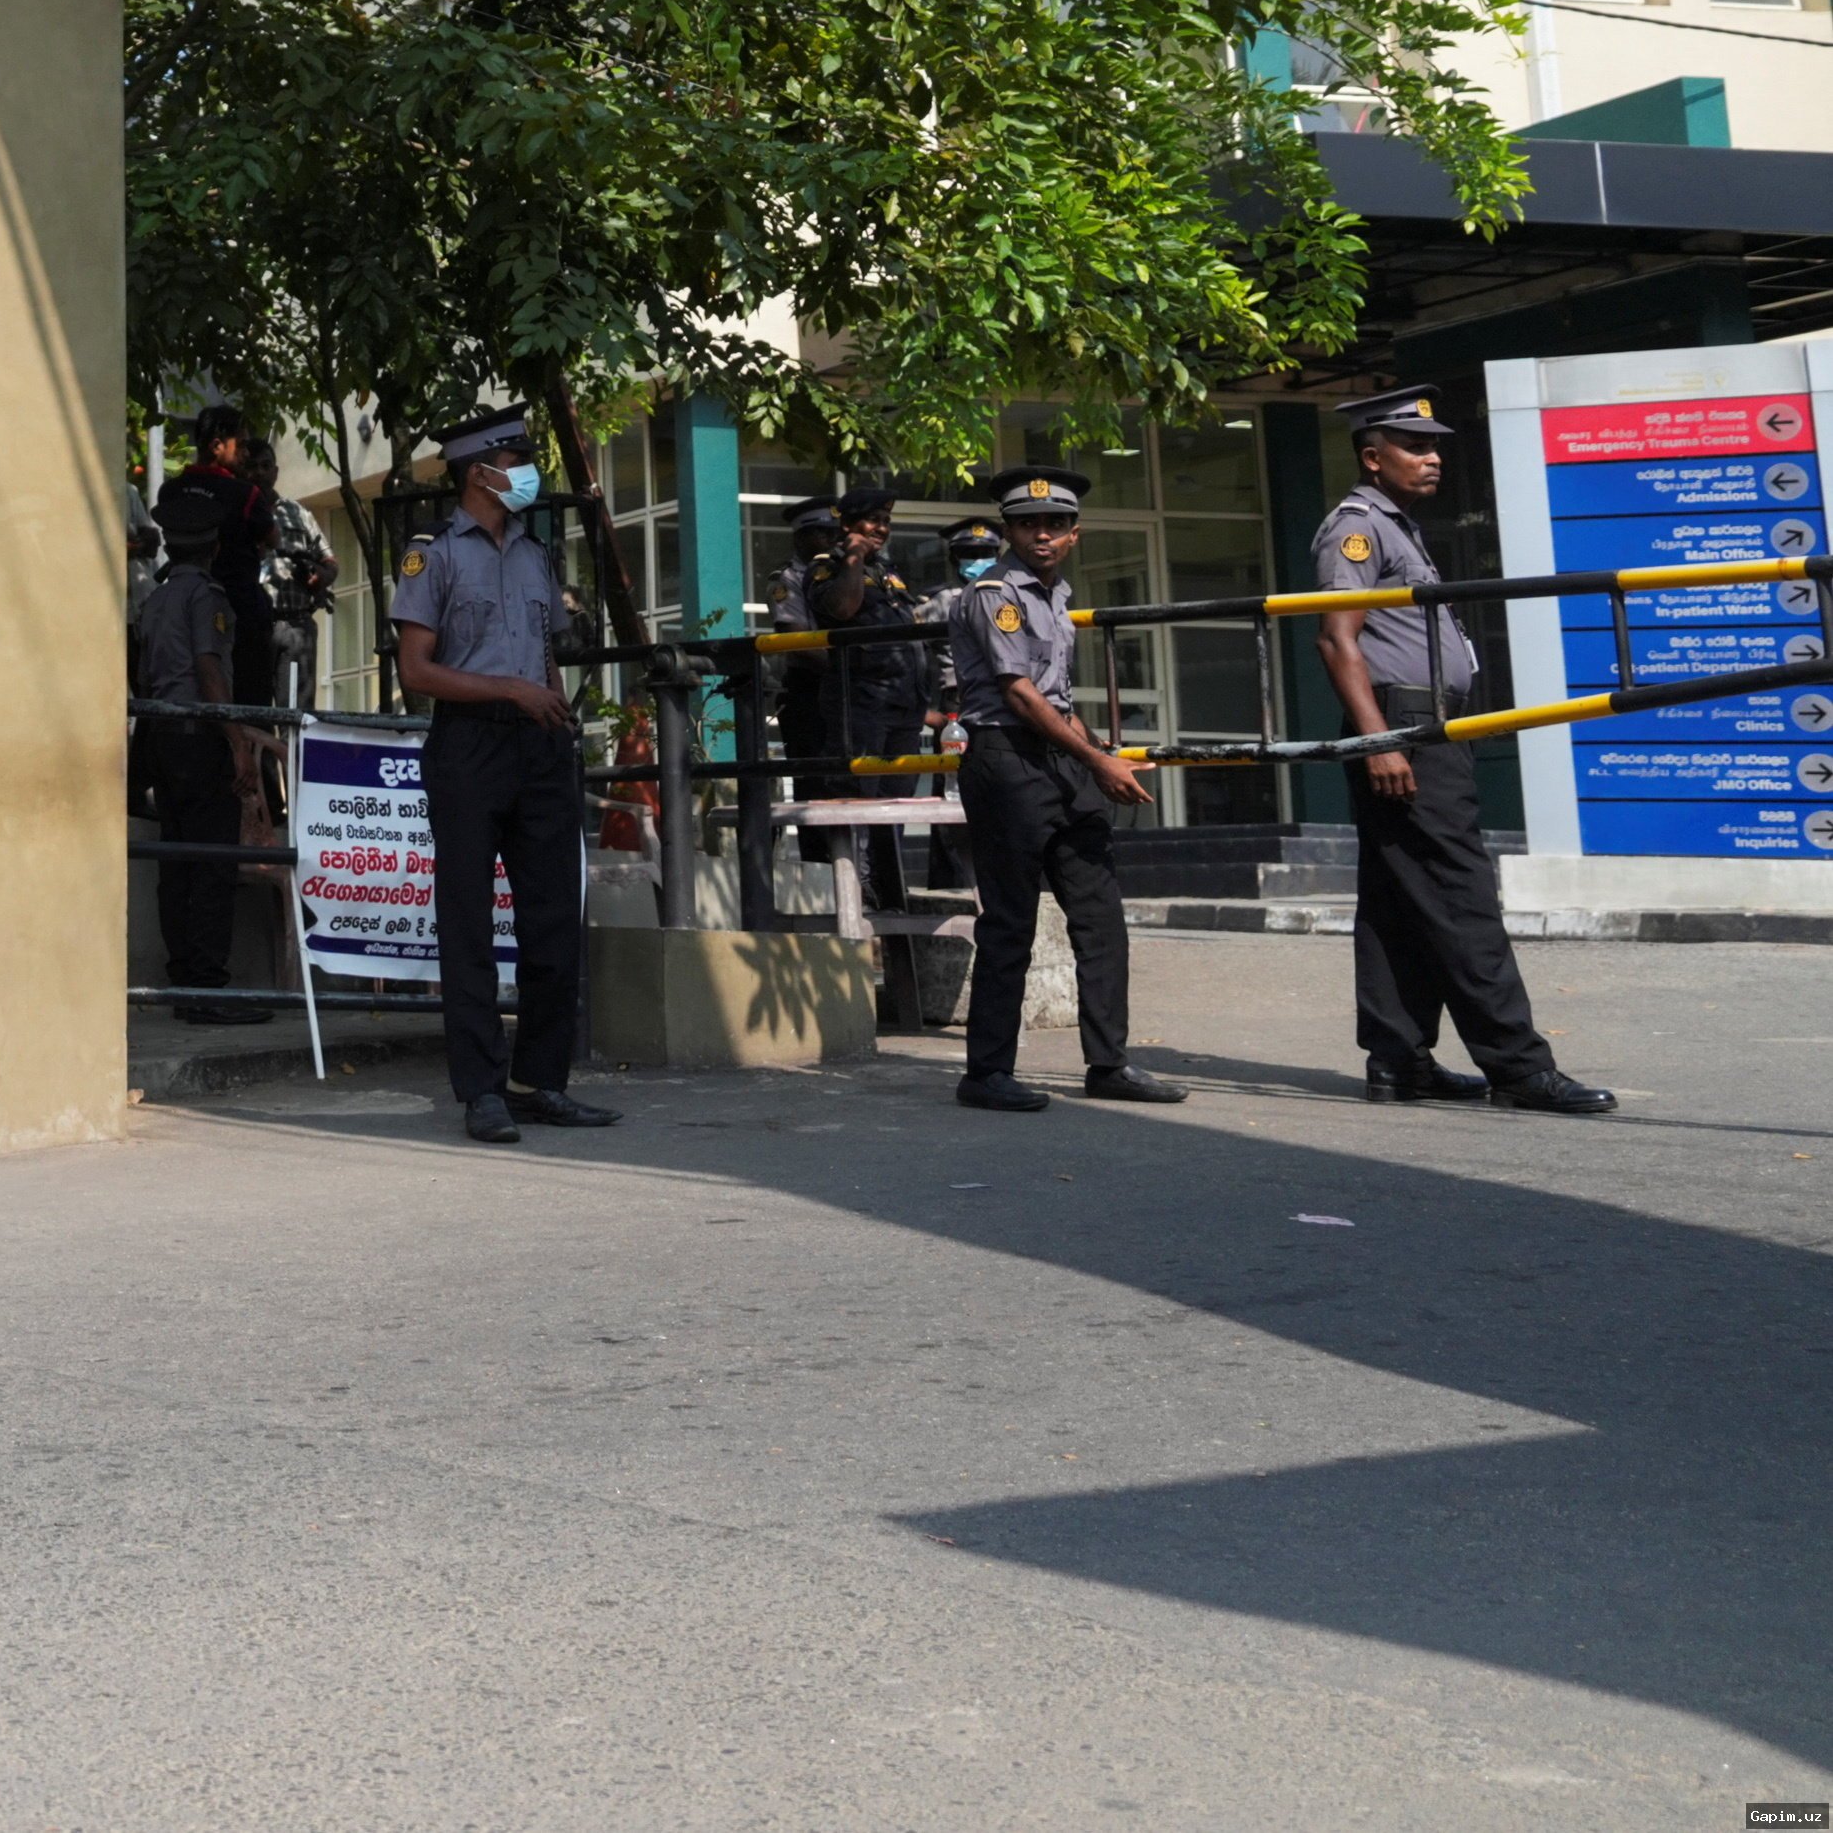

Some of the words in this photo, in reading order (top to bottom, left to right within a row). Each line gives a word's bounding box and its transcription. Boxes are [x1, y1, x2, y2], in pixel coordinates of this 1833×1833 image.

[1568, 439, 1645, 454] Emergency
[1647, 437, 1699, 450] Trauma
[1701, 434, 1750, 447] Centre
[1676, 489, 1758, 504] Admissions
[1685, 549, 1720, 561] Main
[1721, 547, 1765, 560] Office
[1655, 605, 1724, 619] In-patient
[1725, 603, 1772, 616] Wards
[1610, 662, 1690, 676] Ot-patient
[1735, 719, 1785, 732] Clinics
[1711, 779, 1746, 791] JMO
[1747, 779, 1792, 791] Office
[397, 798, 429, 819] භාවි
[1734, 835, 1800, 850] Inquiries
